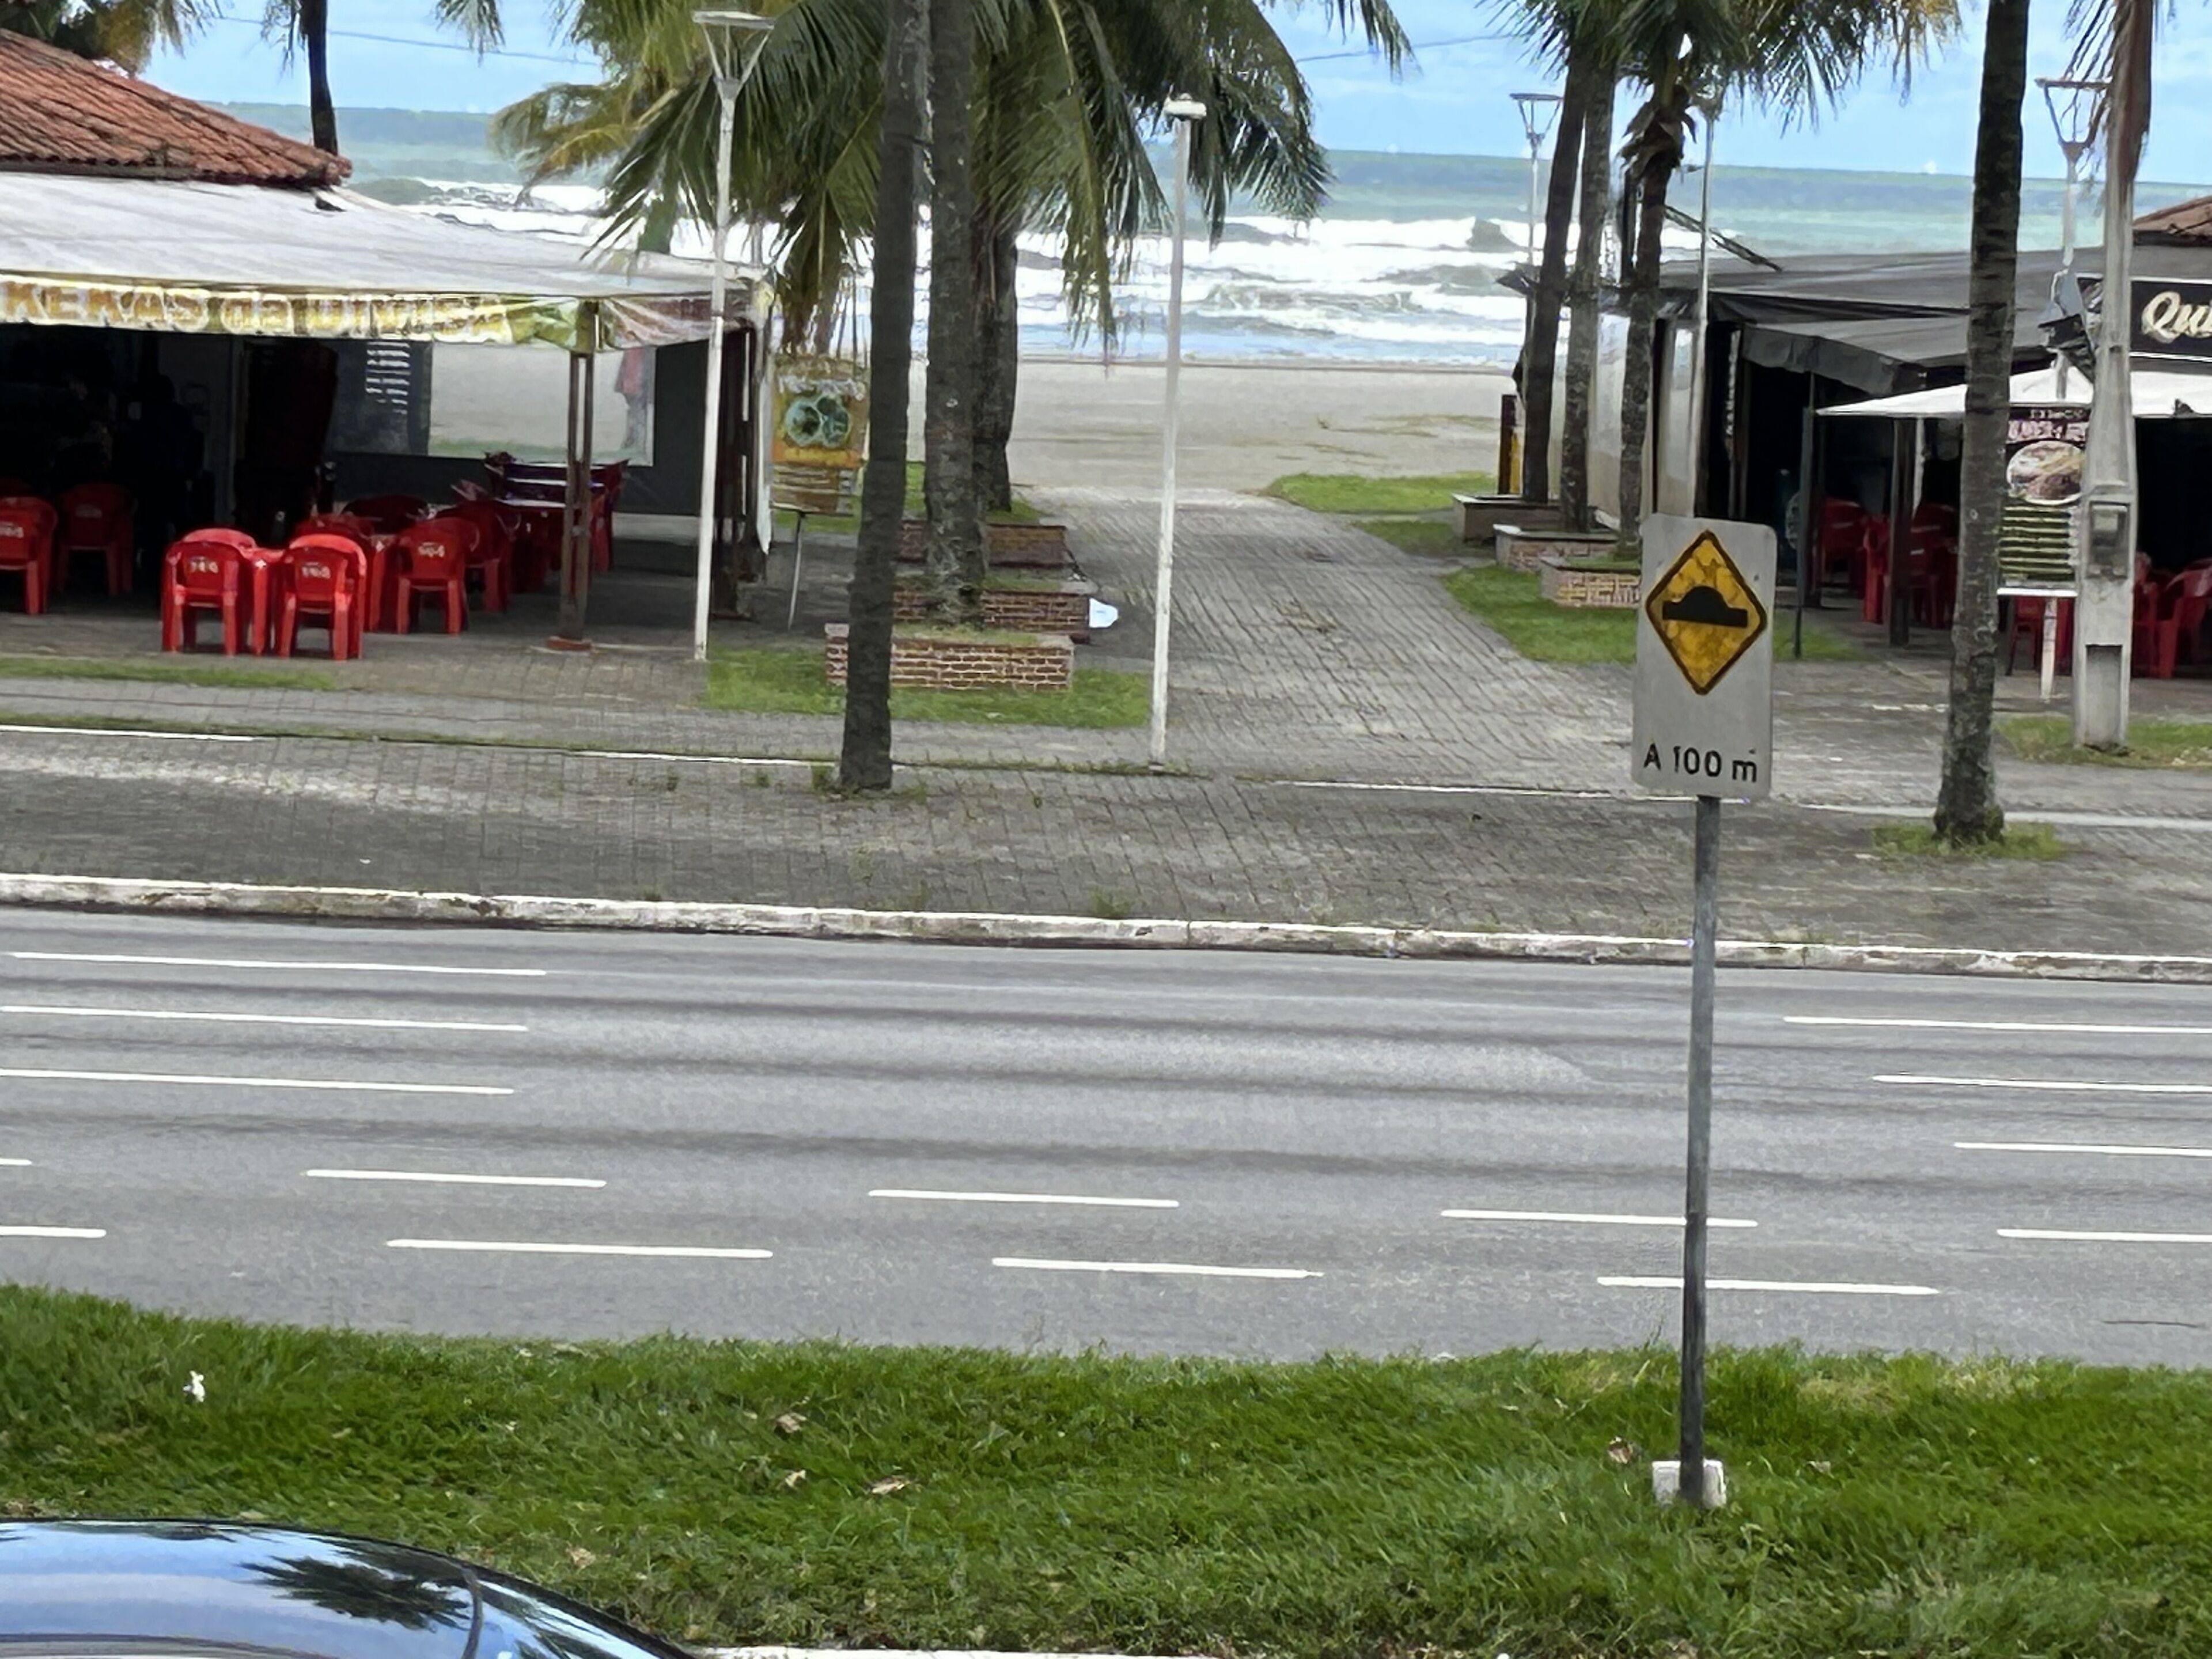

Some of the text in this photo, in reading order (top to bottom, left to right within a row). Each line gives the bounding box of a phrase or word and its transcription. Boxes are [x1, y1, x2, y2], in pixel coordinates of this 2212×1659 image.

[1643, 743, 1756, 783] A 100 m
